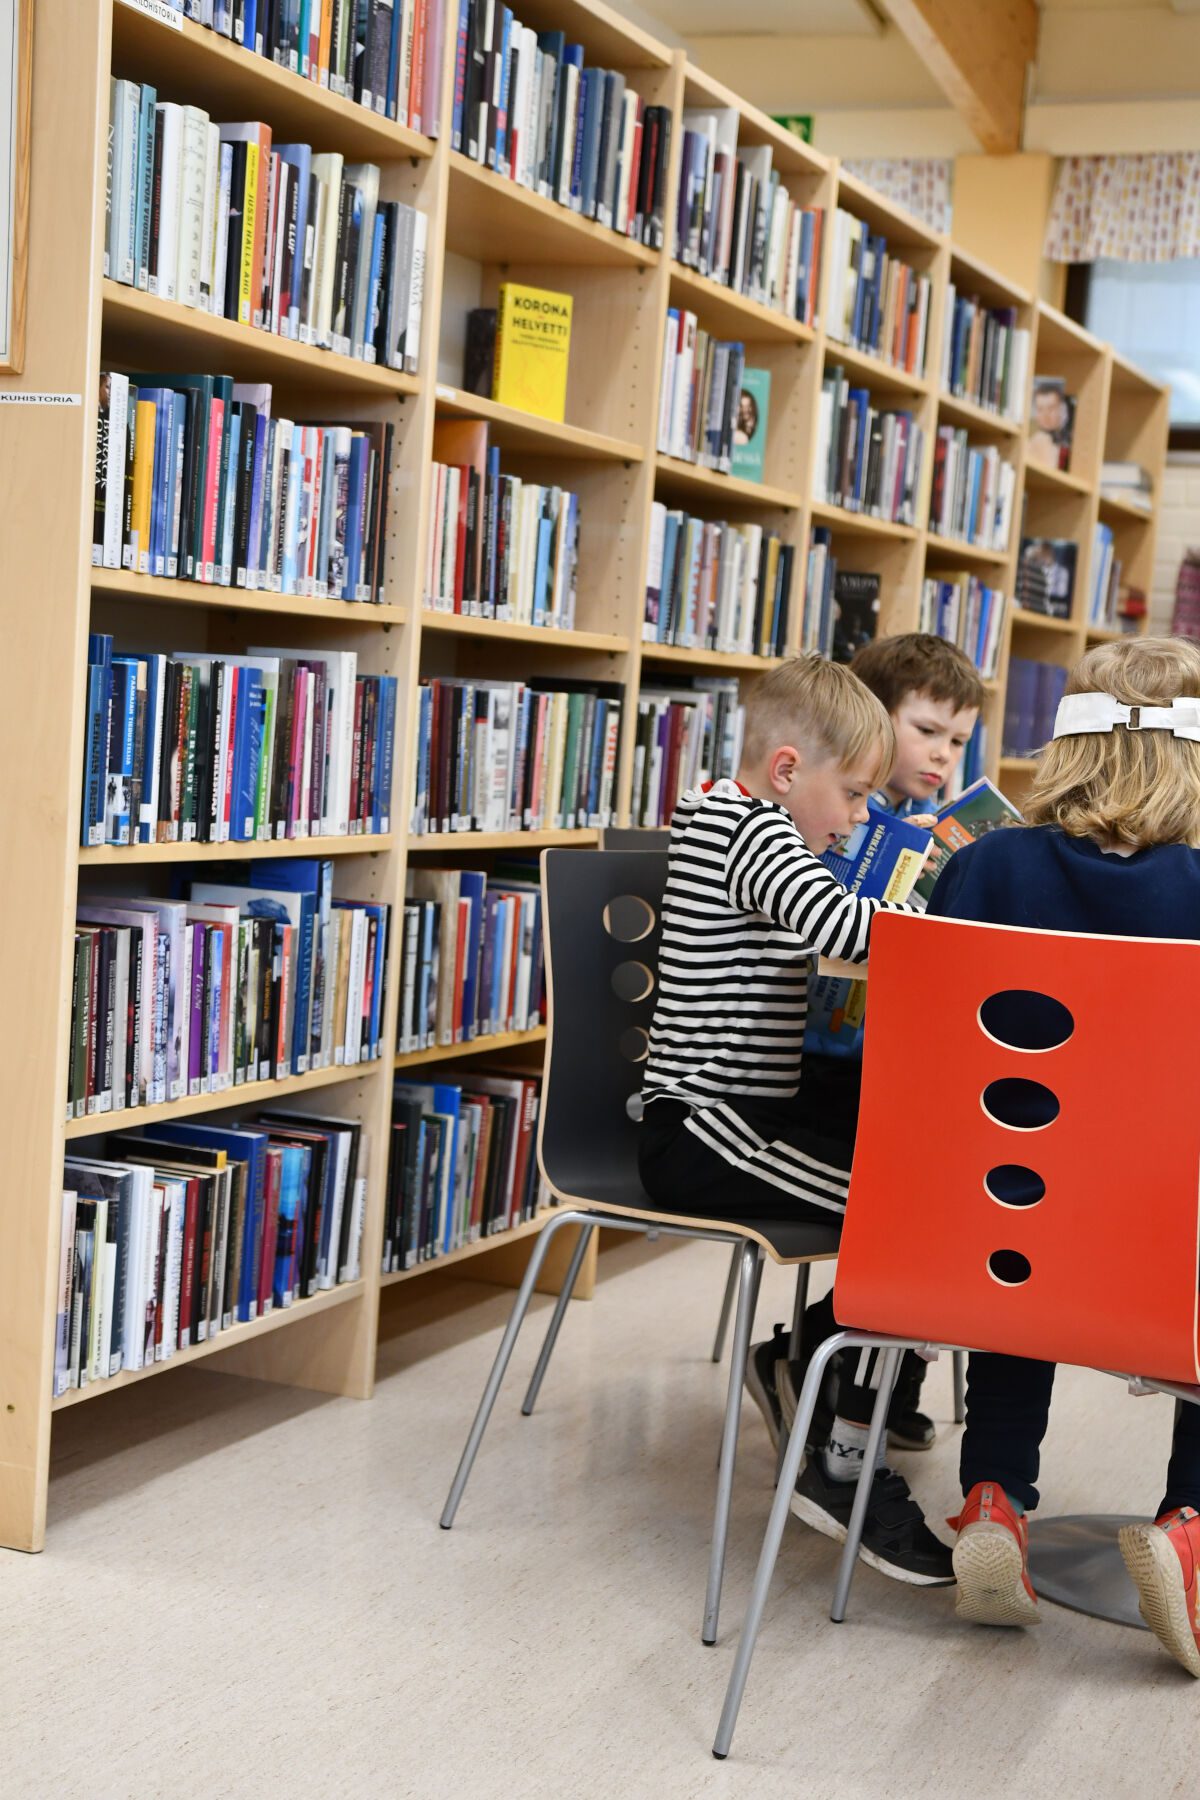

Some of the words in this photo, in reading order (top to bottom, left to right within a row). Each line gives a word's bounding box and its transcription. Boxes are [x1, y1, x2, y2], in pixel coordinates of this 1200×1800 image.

[514, 296, 569, 318] KORONA
[512, 316, 567, 336] HELVETTI
[1, 395, 73, 403] KUHISTORIA
[187, 730, 196, 794] ERAKOT
[866, 824, 886, 858] VÄRIKÄS
[856, 857, 871, 880] PÄIVÄ
